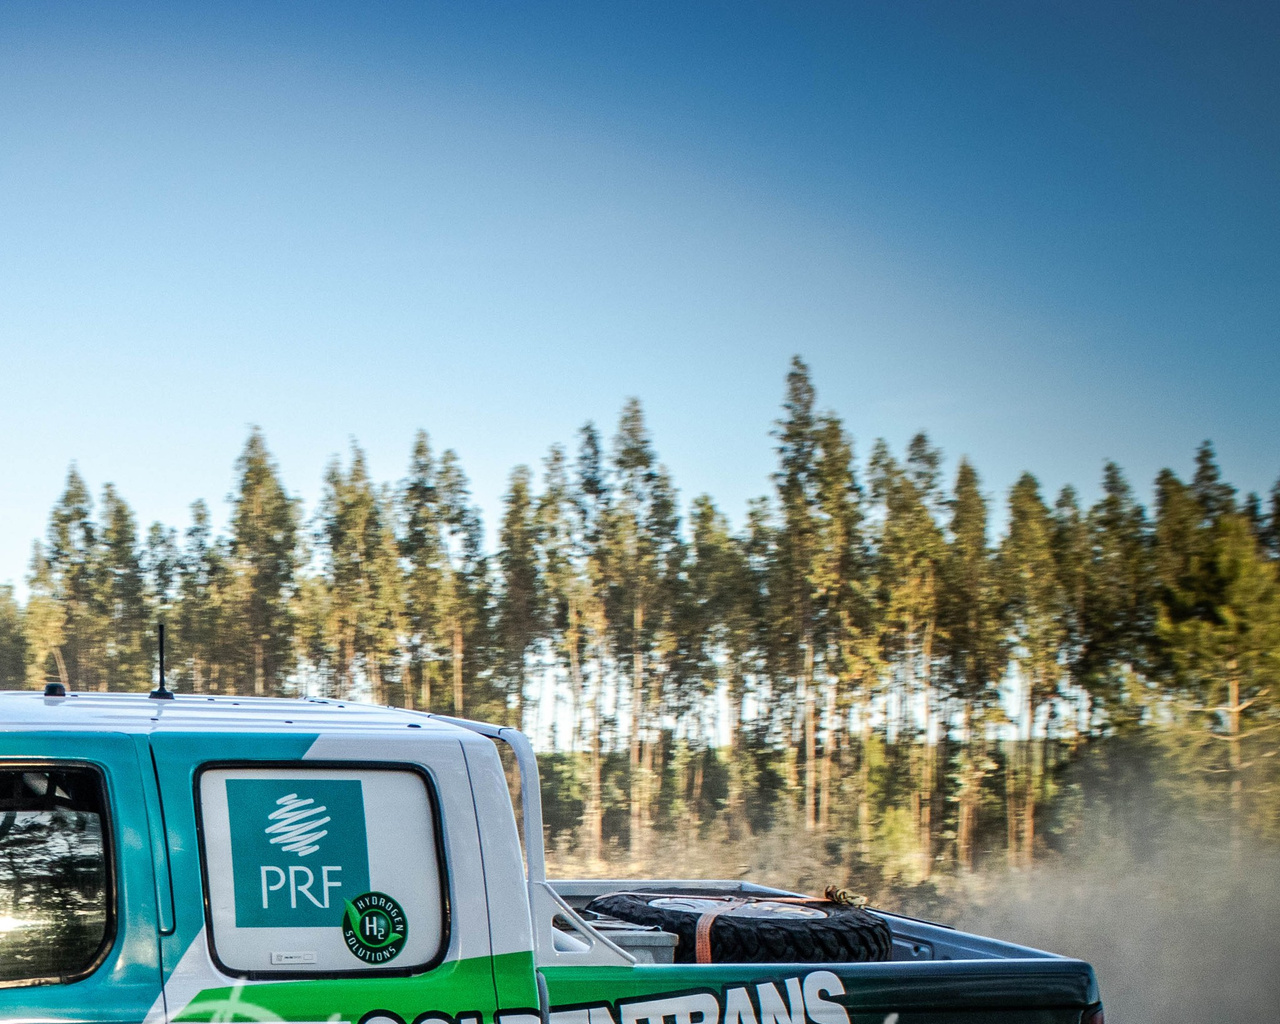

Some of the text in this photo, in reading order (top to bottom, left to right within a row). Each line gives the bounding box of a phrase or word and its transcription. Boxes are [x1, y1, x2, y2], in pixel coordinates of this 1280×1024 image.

[260, 865, 343, 909] PRF
[357, 896, 404, 931] HYDROGEN
[345, 930, 396, 962] SOLUTIONS
